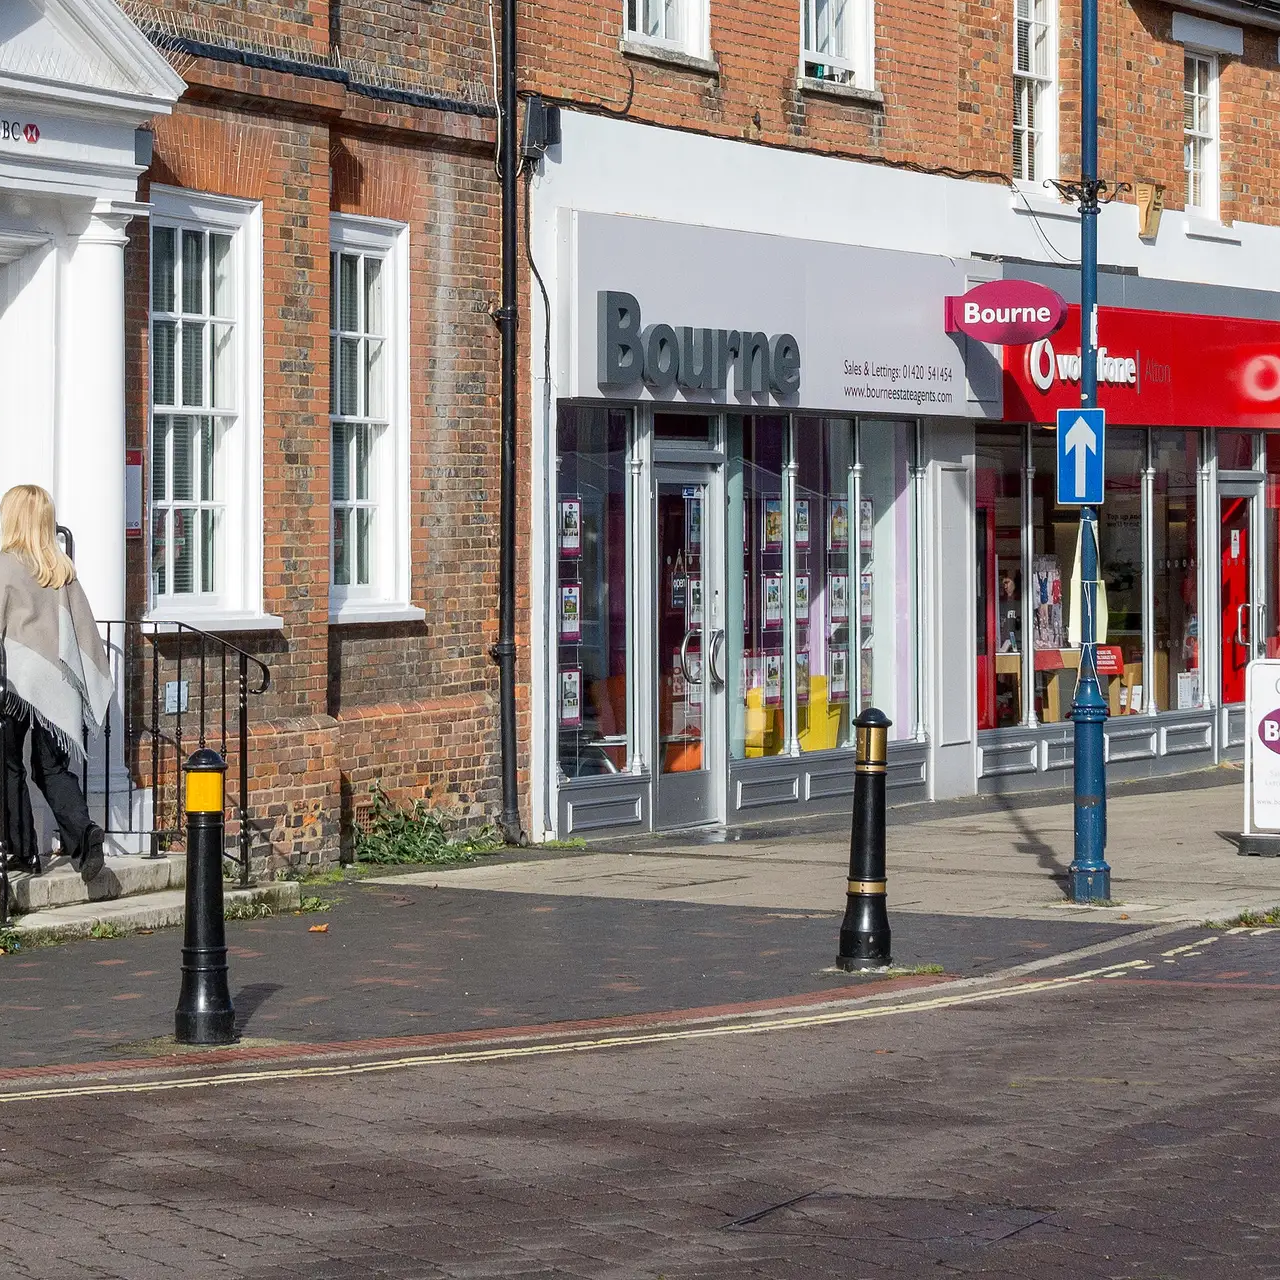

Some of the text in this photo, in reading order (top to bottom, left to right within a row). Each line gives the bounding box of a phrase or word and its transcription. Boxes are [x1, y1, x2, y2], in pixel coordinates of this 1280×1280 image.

[964, 302, 1051, 324] Bourne
[597, 290, 800, 395] Bourne
[843, 359, 953, 382] Sales & Lettings: 01420 541454
[1056, 347, 1171, 383] vofone Alton
[843, 383, 953, 405] www.bourneestateagents.com
